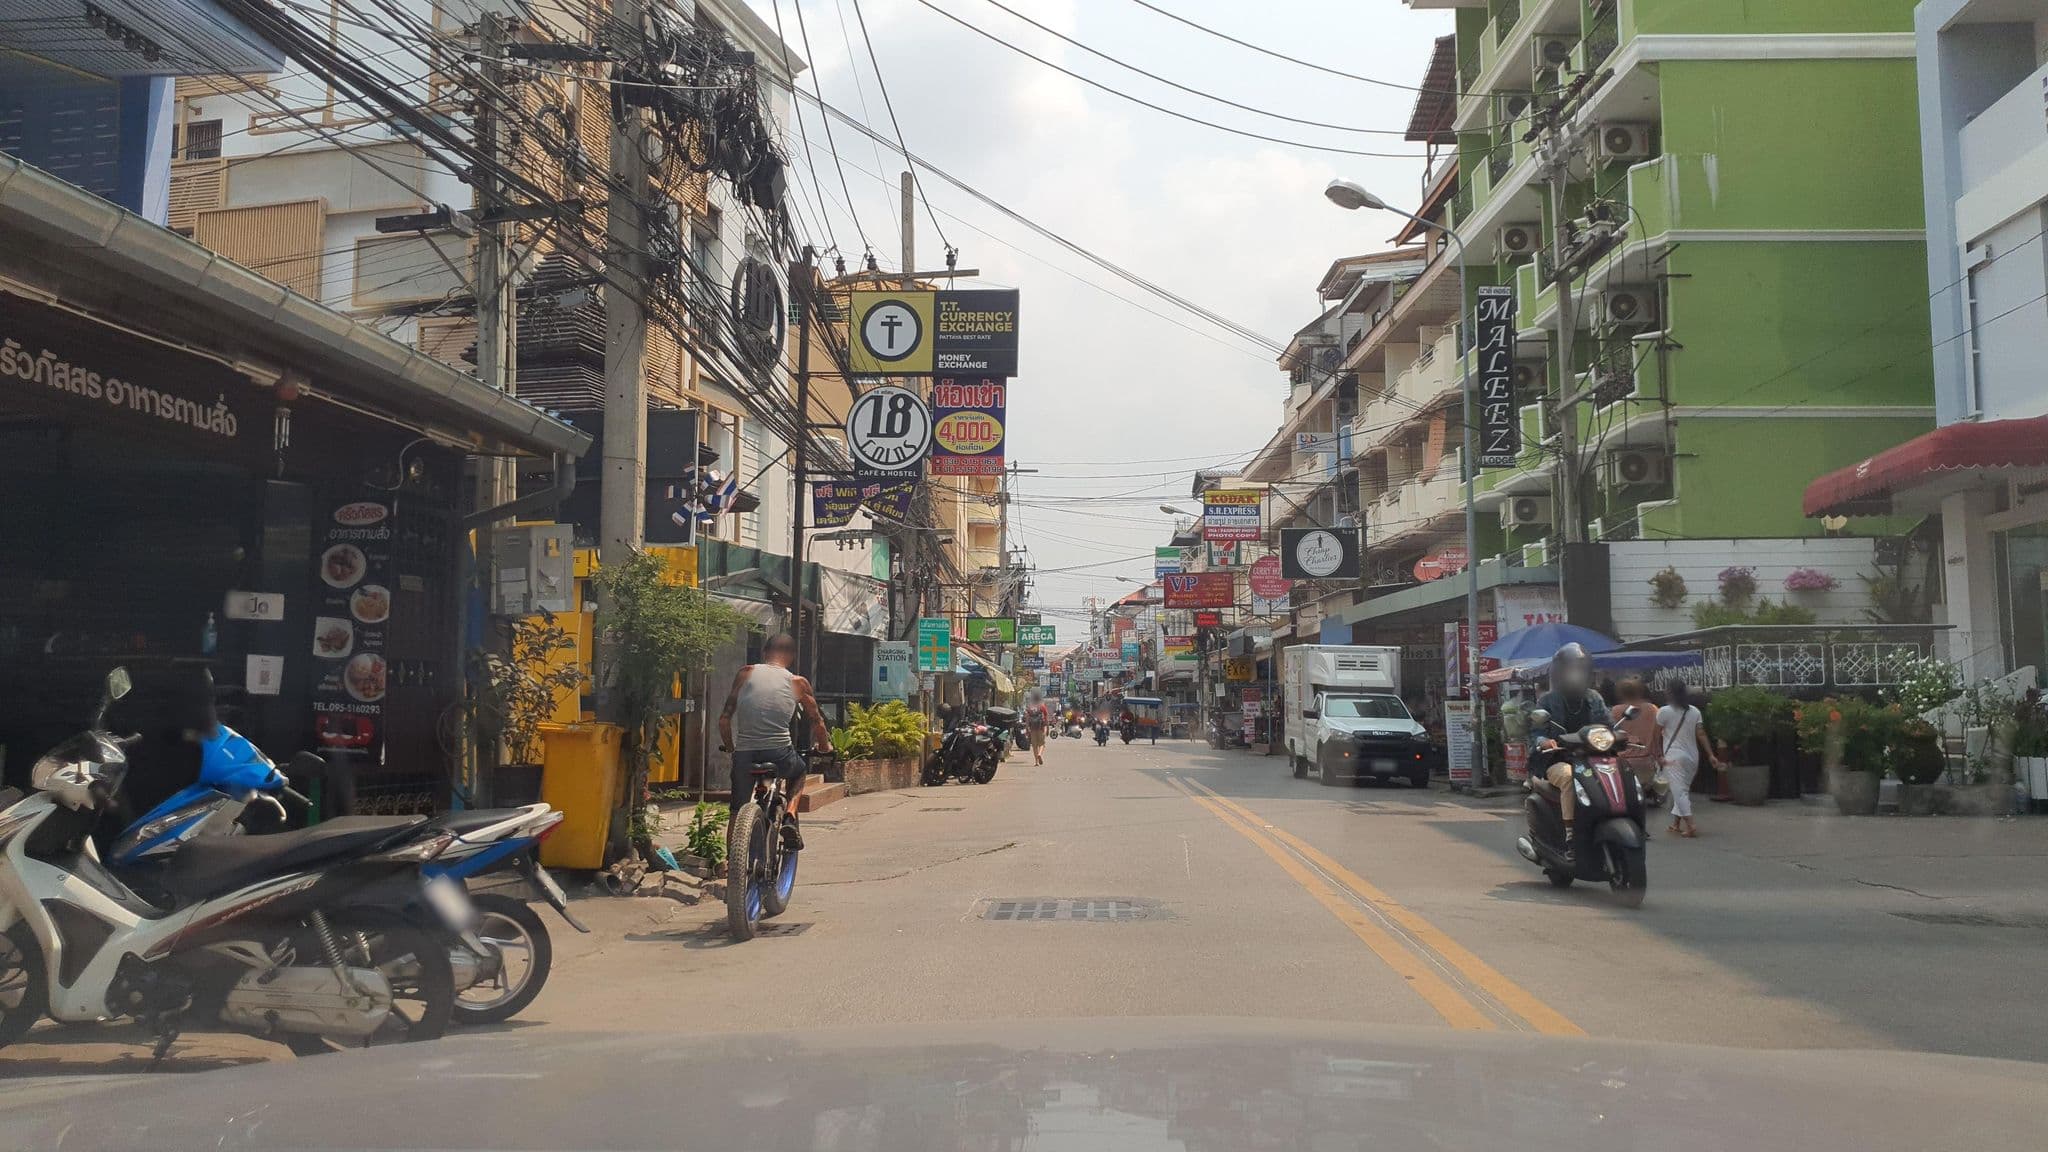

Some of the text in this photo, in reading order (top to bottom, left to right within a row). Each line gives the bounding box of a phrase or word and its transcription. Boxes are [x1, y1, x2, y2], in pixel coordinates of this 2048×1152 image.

[940, 302, 960, 311] T.T.
[940, 312, 1013, 321] CURRENCY
[940, 322, 1013, 332] EXCHANGE
[1480, 298, 1511, 452] MALEEZ
[935, 379, 1005, 409] ห้องเช่า
[106, 378, 237, 437] อาหารตามสั่ง
[866, 393, 913, 438] 18
[815, 484, 833, 498] ฟรี
[1210, 495, 1257, 503] KODAK
[1168, 576, 1198, 592] VP
